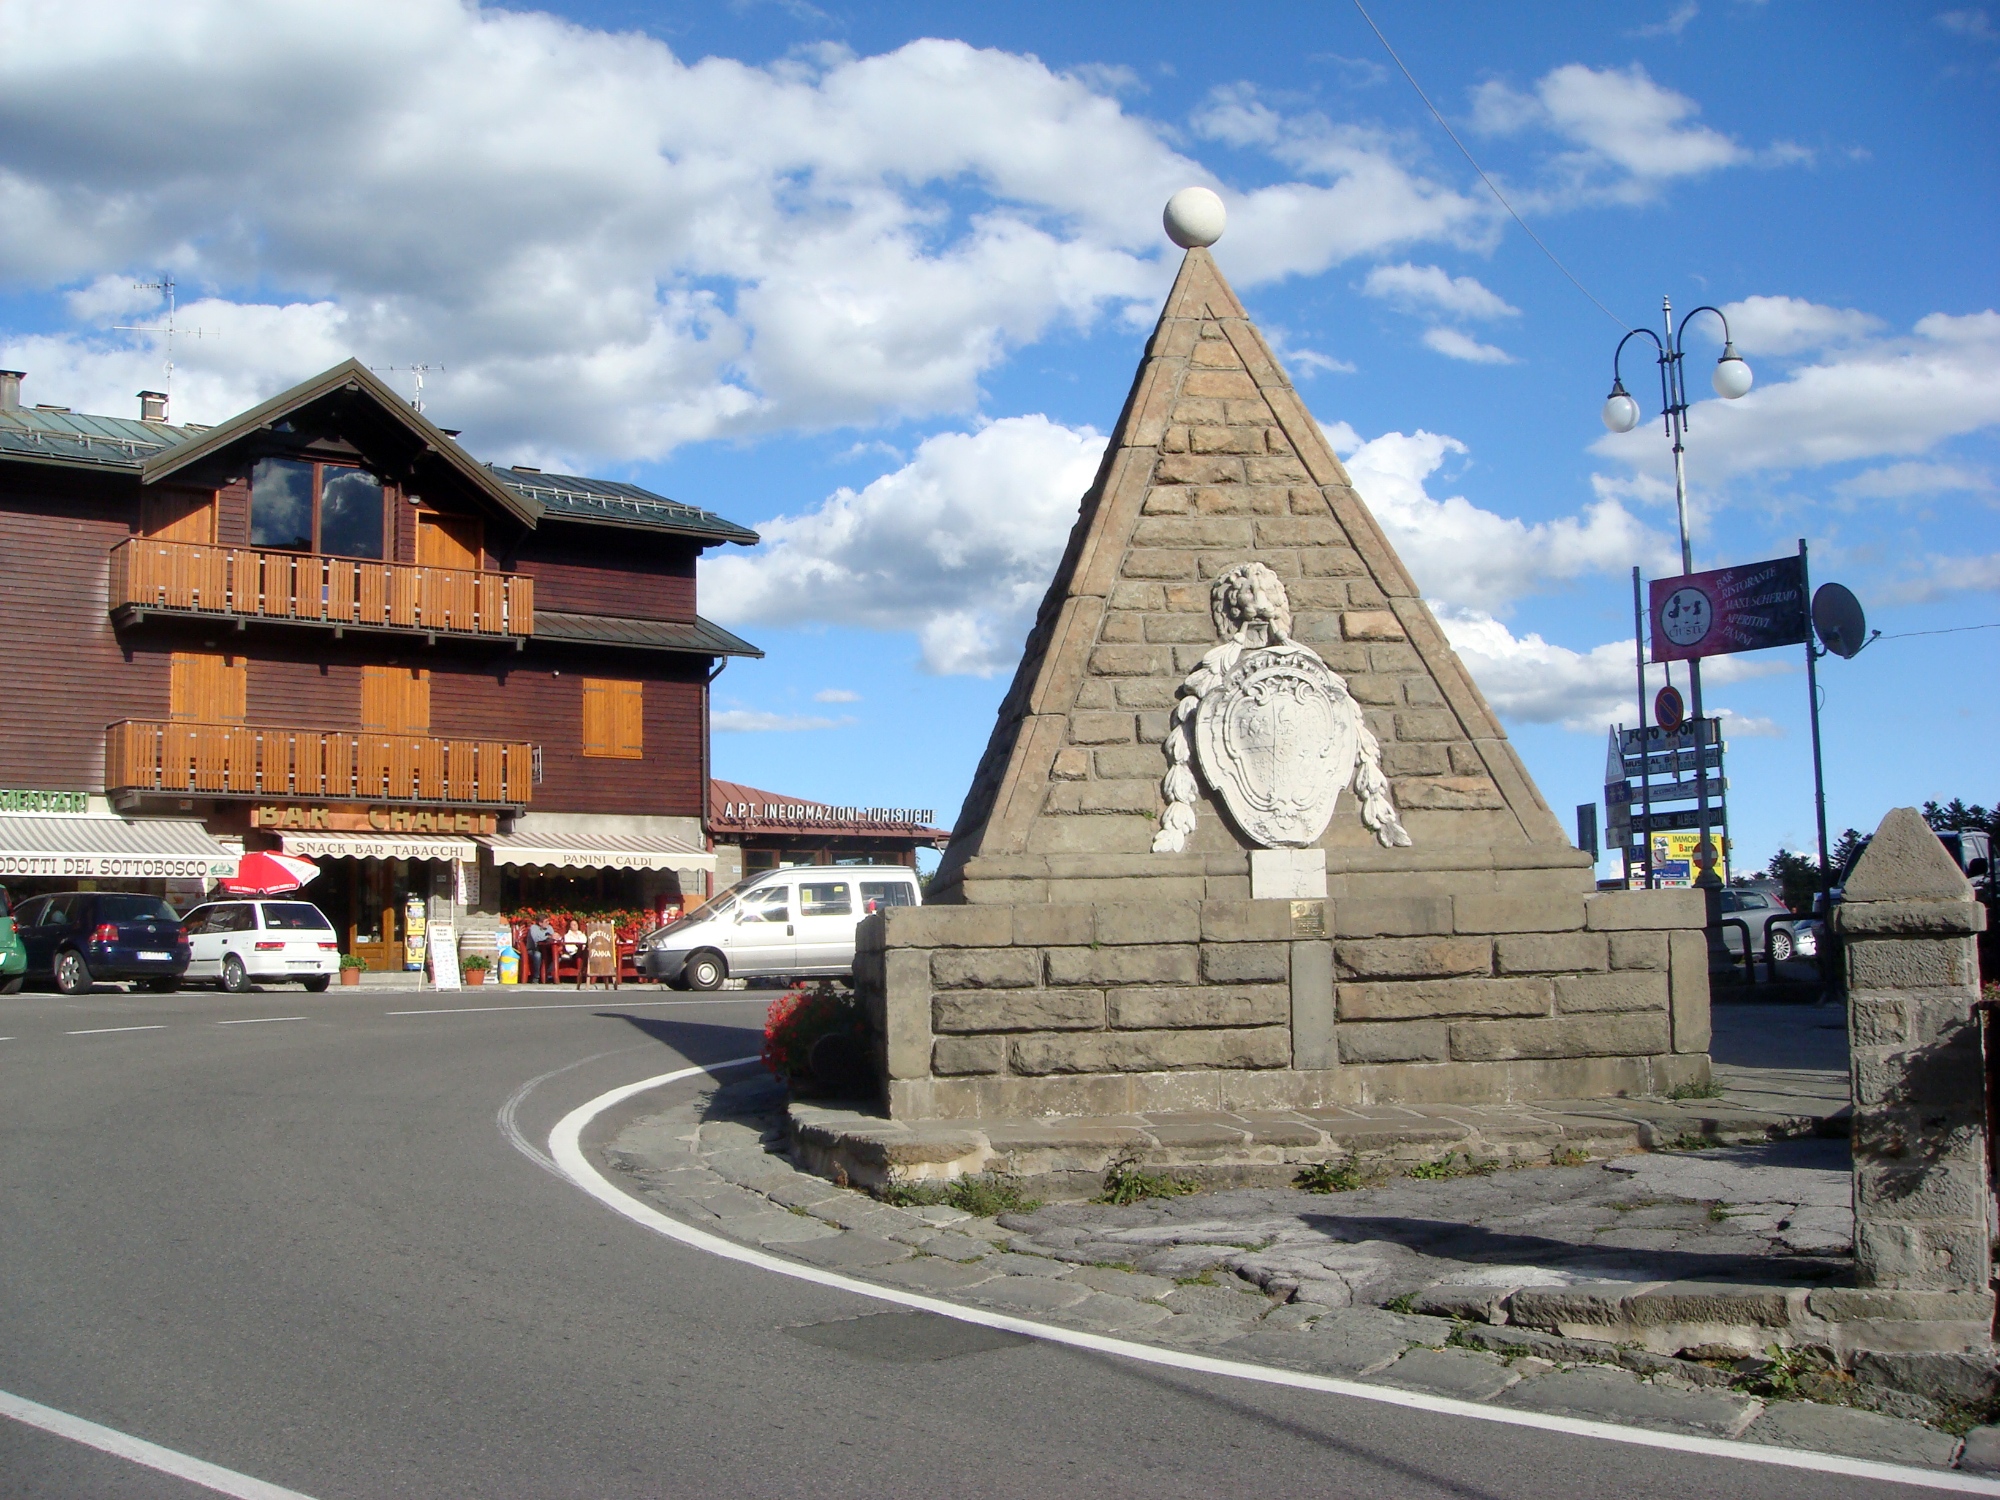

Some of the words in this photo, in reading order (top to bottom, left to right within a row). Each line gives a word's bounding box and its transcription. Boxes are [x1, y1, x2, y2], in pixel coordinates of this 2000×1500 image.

[1716, 571, 1734, 589] BAR
[1721, 567, 1777, 599] RISTORANTE
[1726, 613, 1771, 628] APERITIVI
[1722, 625, 1753, 646] PANINI
[259, 803, 329, 828] BAR
[368, 805, 491, 833] CHALET
[725, 801, 756, 818] A.P.T.
[865, 806, 938, 824] TURISTICHE
[296, 842, 346, 854] SNACK
[355, 844, 384, 855] BAR
[392, 845, 464, 857] TABACCHI
[63, 858, 94, 874] DEL
[100, 859, 207, 876] SOTTOBOSCO
[563, 854, 606, 864] PANINI
[615, 856, 652, 866] CALDI
